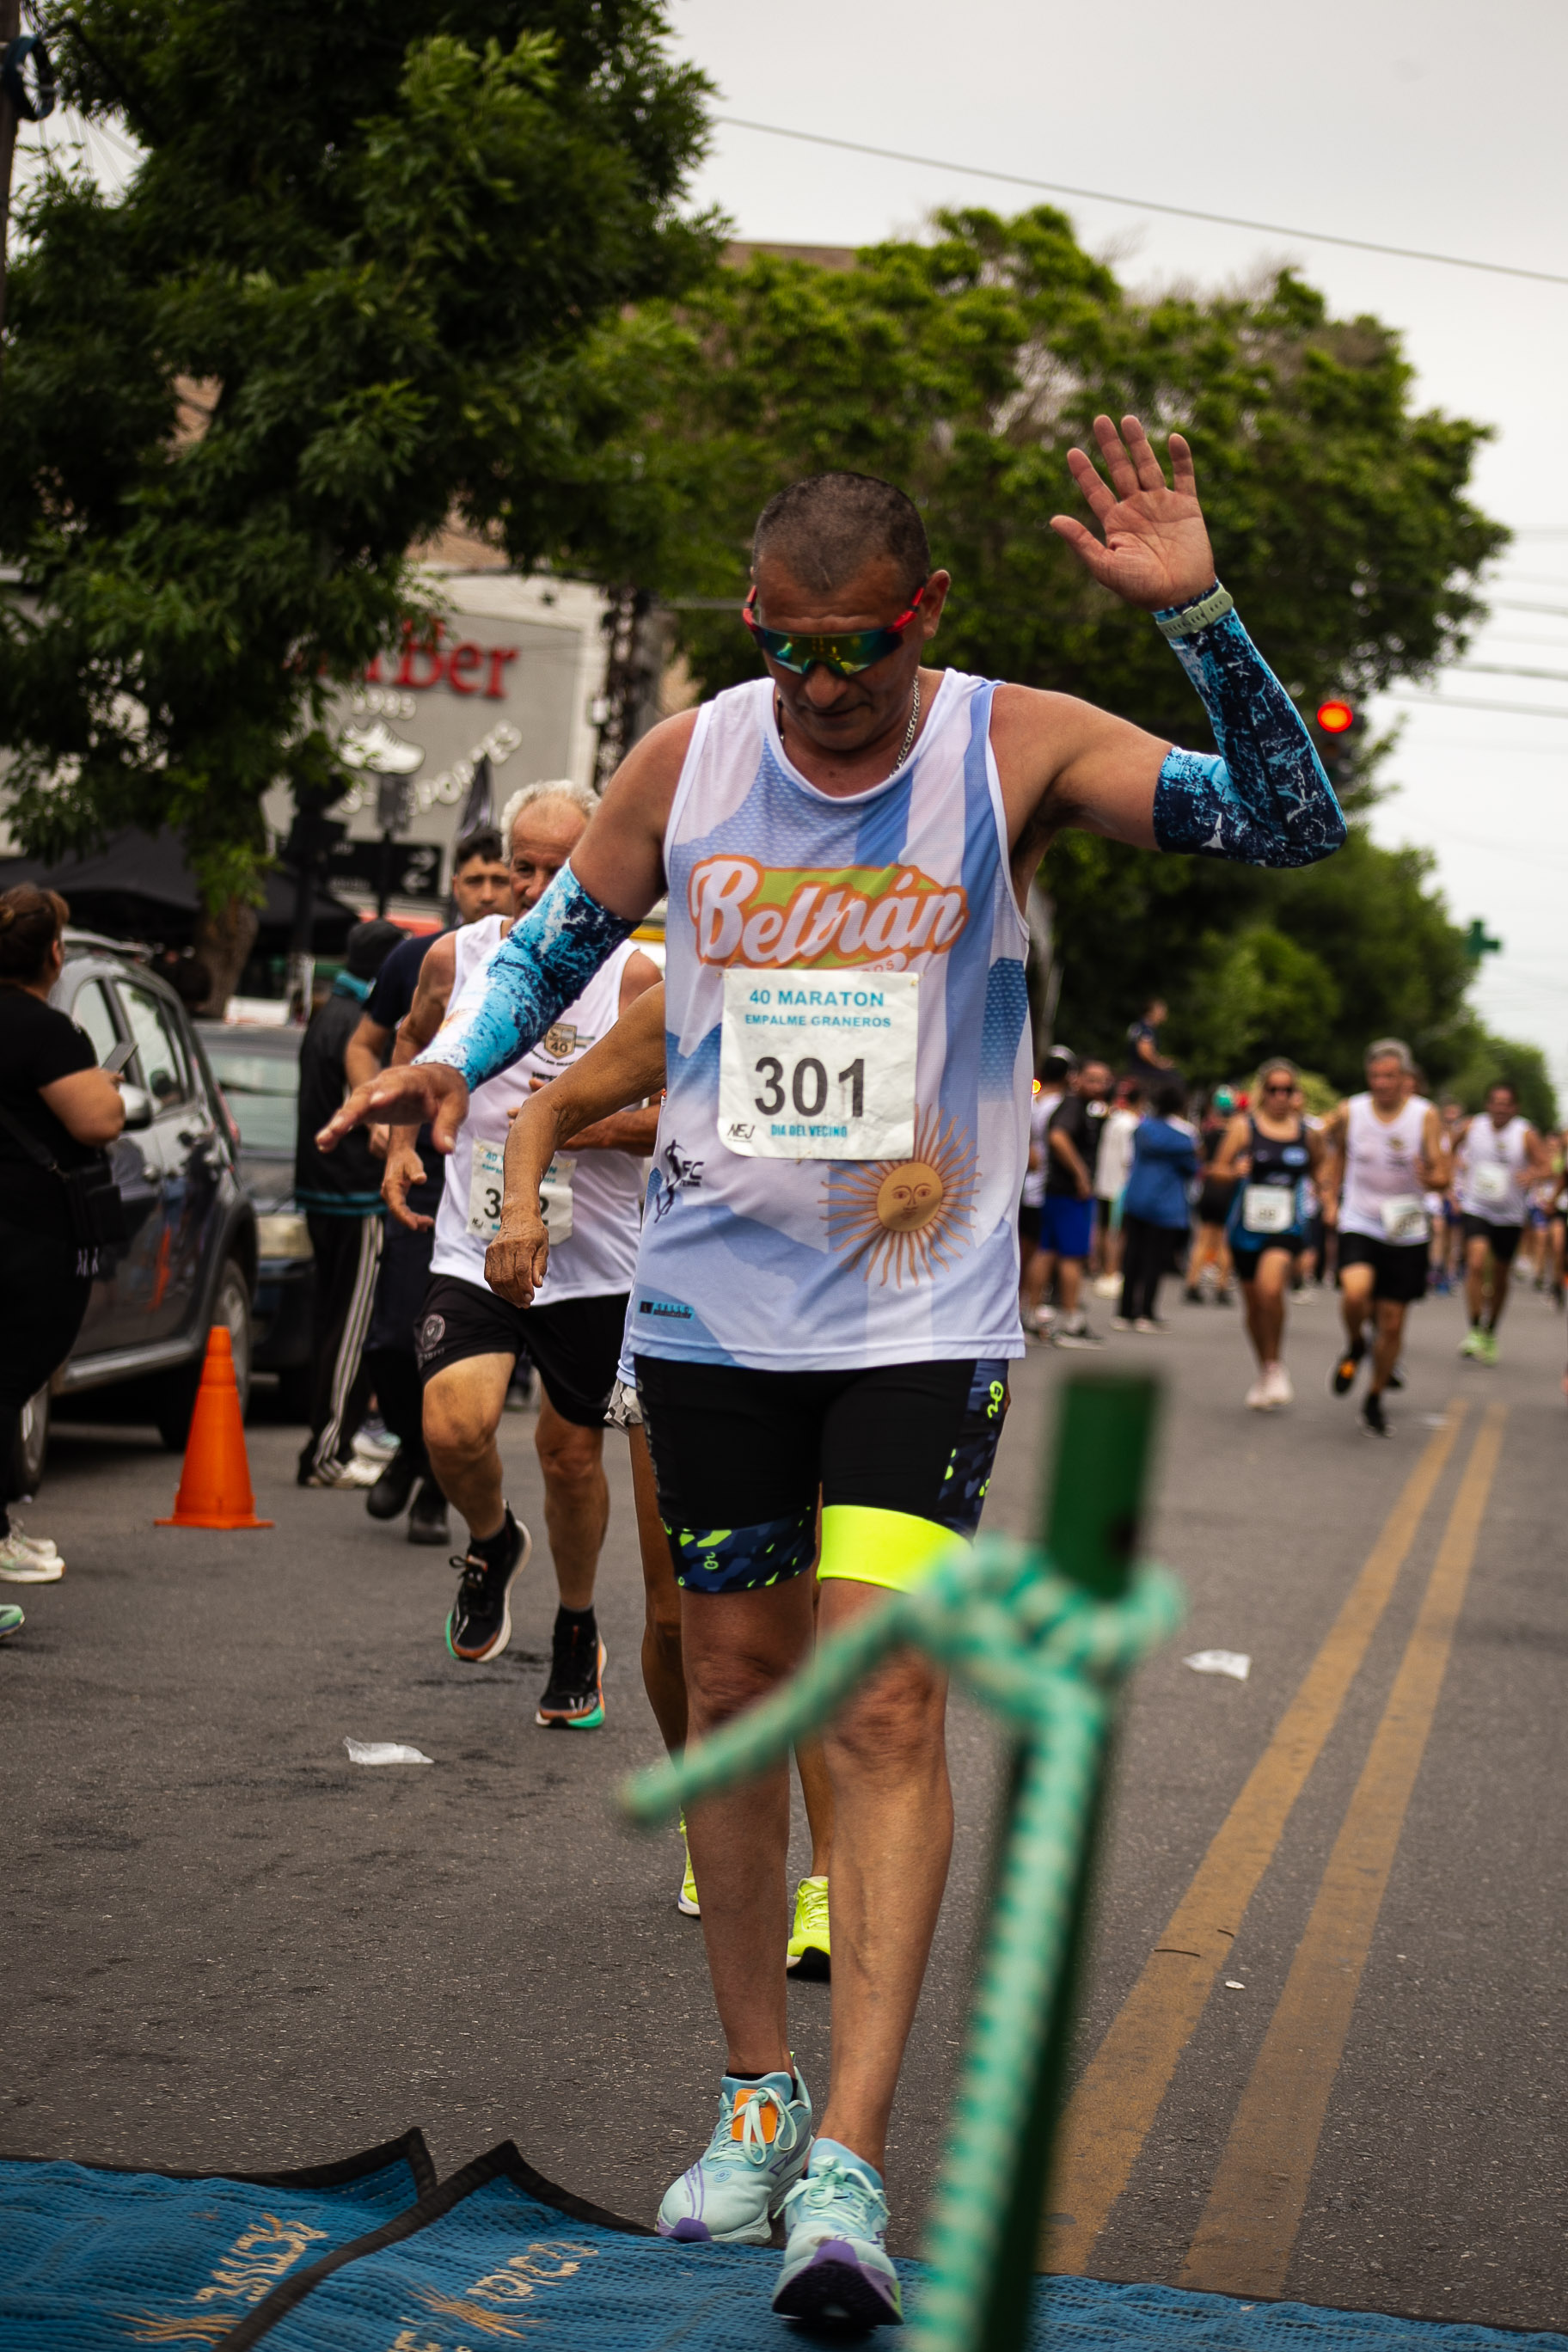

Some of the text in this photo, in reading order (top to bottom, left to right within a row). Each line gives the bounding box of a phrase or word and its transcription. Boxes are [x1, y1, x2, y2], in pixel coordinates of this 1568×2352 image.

[691, 858, 966, 963] Beltrán
[749, 989, 885, 1008] 40 MARATON
[744, 1014, 891, 1027] EMPALME GRANEROS
[551, 1041, 568, 1053] 40
[754, 1056, 865, 1118] 301
[771, 1124, 847, 1137] DIA DEL VECINO
[484, 1188, 549, 1226] 32
